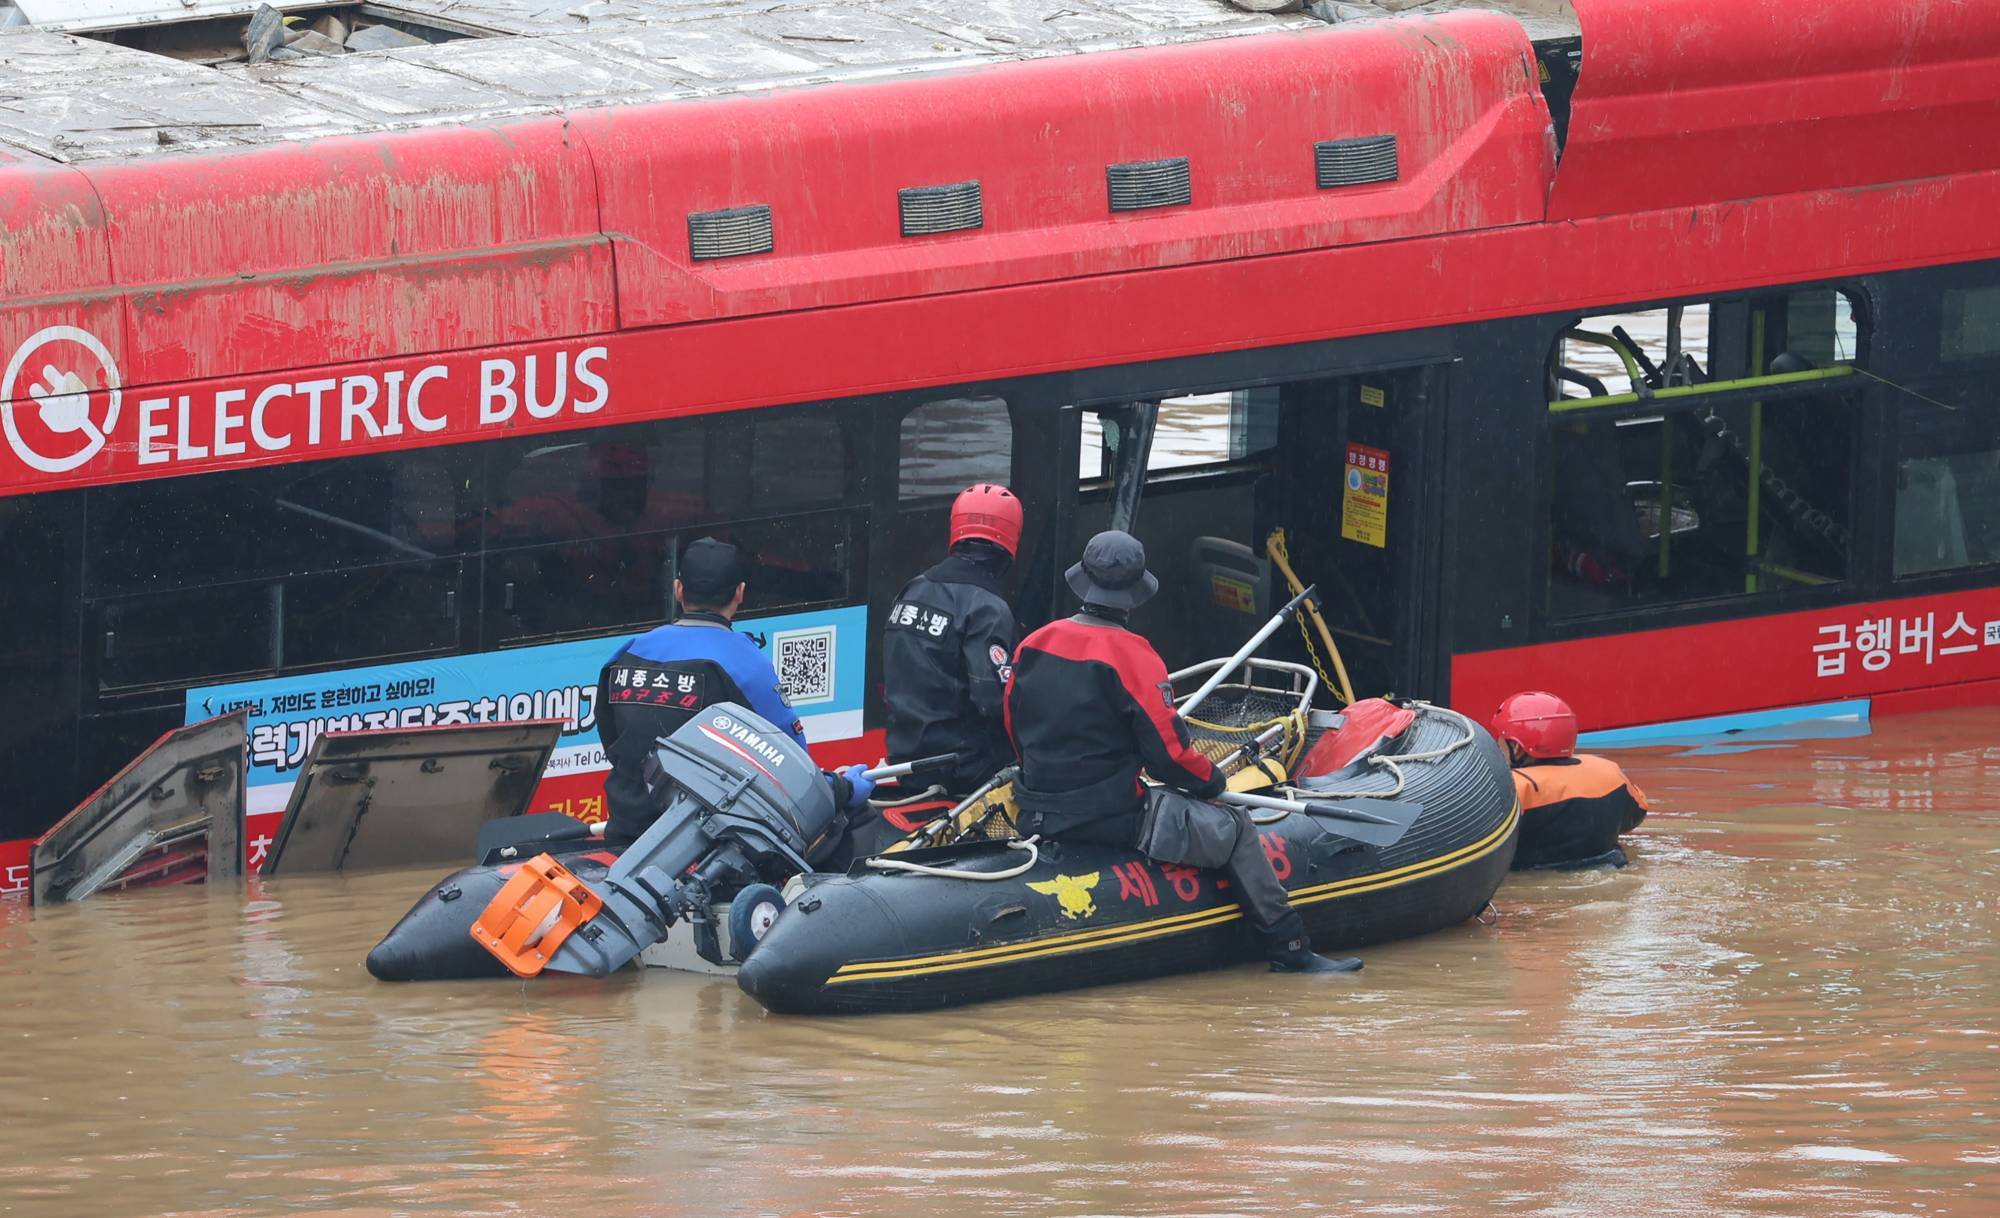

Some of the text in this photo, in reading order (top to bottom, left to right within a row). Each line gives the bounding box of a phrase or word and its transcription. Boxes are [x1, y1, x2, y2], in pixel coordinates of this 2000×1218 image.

[137, 347, 609, 466] ELECTRIC BUS
[1812, 611, 1979, 678] 급행버스
[271, 692, 317, 713] 저희도
[321, 684, 381, 707] 훈련하고
[385, 677, 435, 700] 싶어요!
[614, 668, 696, 693] 세종소방
[547, 750, 608, 769] 북지사 Tel 04
[728, 722, 785, 767] YAMAHA
[1112, 831, 1291, 906] 세종방
